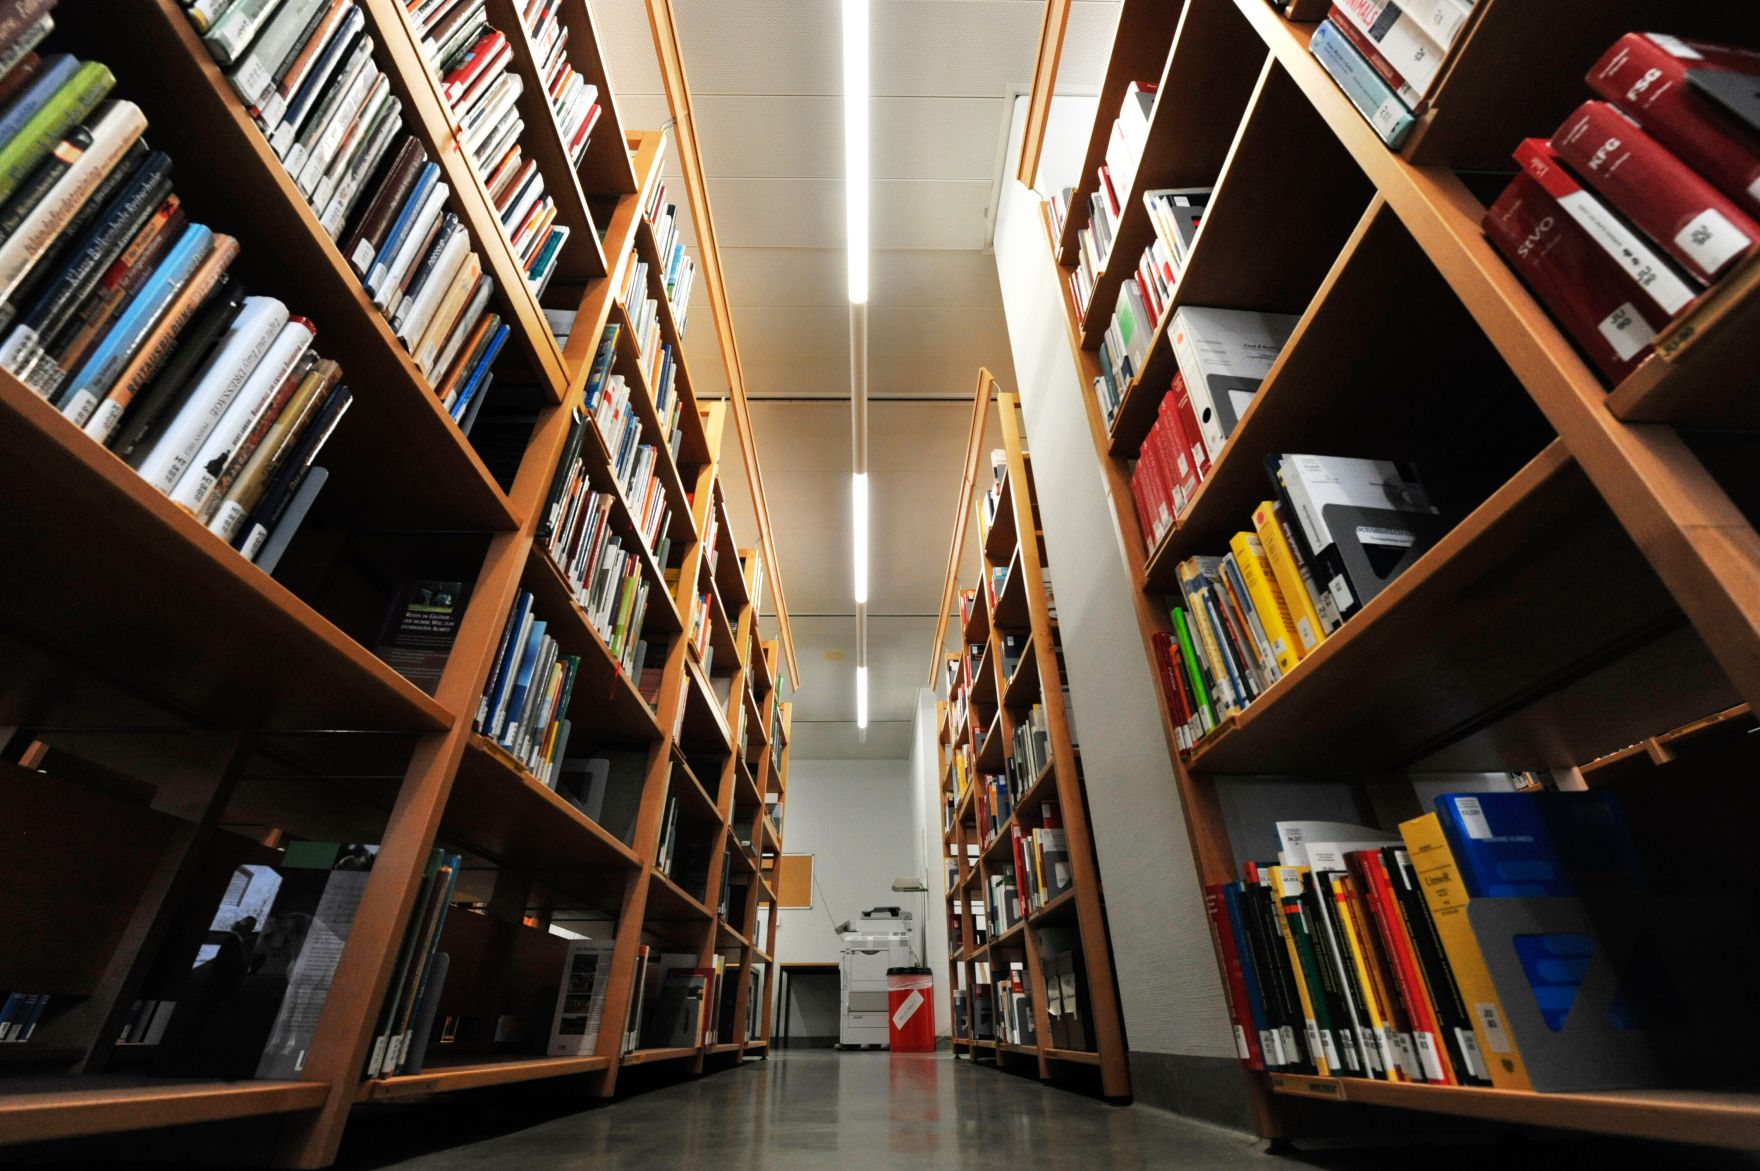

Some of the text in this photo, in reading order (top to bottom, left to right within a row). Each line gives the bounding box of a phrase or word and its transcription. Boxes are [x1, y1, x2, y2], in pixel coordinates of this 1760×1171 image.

[1624, 63, 1664, 103] FSG
[1585, 134, 1622, 171] KFG
[1514, 212, 1557, 260] StVO
[125, 303, 195, 394] REITAUSBILDUNG
[208, 366, 247, 419] DRESSAGE
